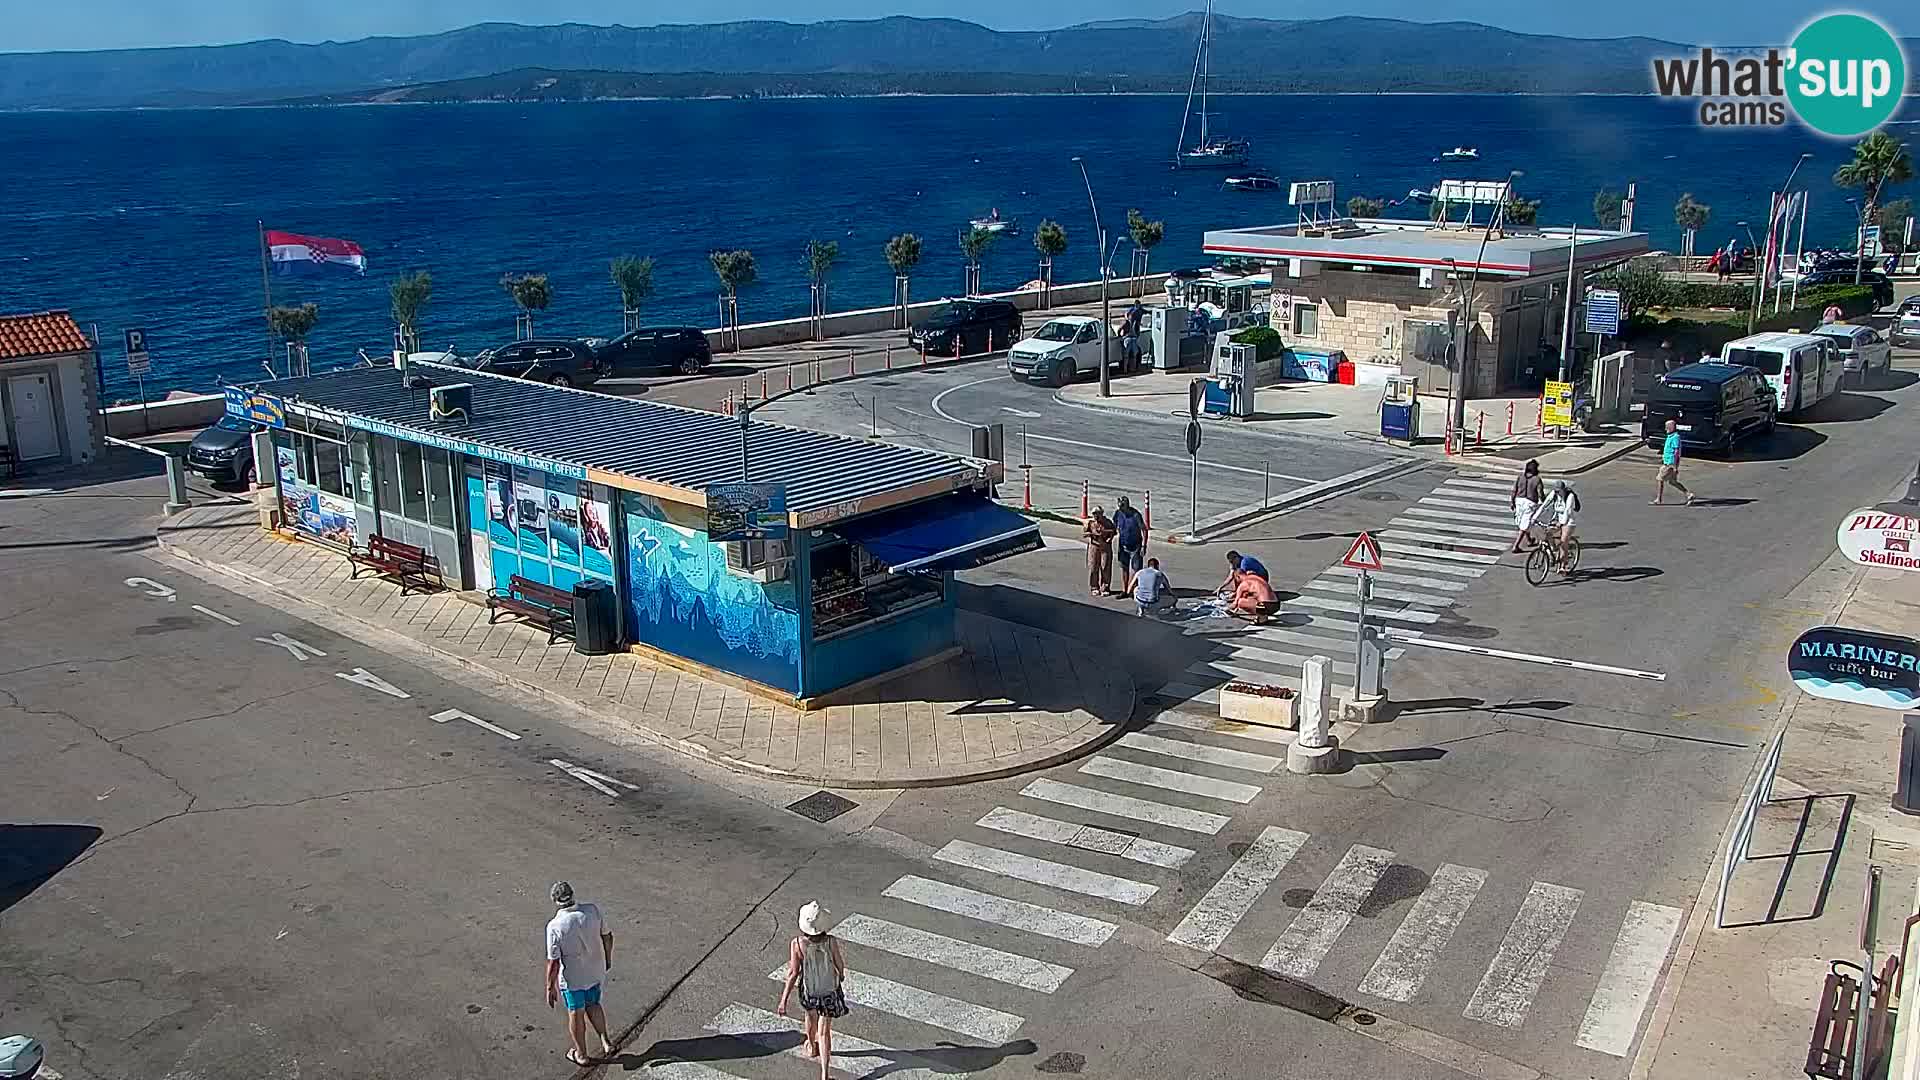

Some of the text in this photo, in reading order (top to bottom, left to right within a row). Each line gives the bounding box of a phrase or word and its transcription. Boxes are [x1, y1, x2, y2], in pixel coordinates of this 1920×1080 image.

[131, 334, 144, 354] P
[437, 437, 468, 453] POSTAJA
[479, 446, 494, 458] BUS
[494, 449, 526, 465] STATION
[528, 457, 554, 471] TICKET
[555, 463, 583, 478] OFFICE
[1847, 515, 1920, 533] PIZZE
[1881, 530, 1917, 541] GRILL
[1828, 662, 1897, 680] caffe bar
